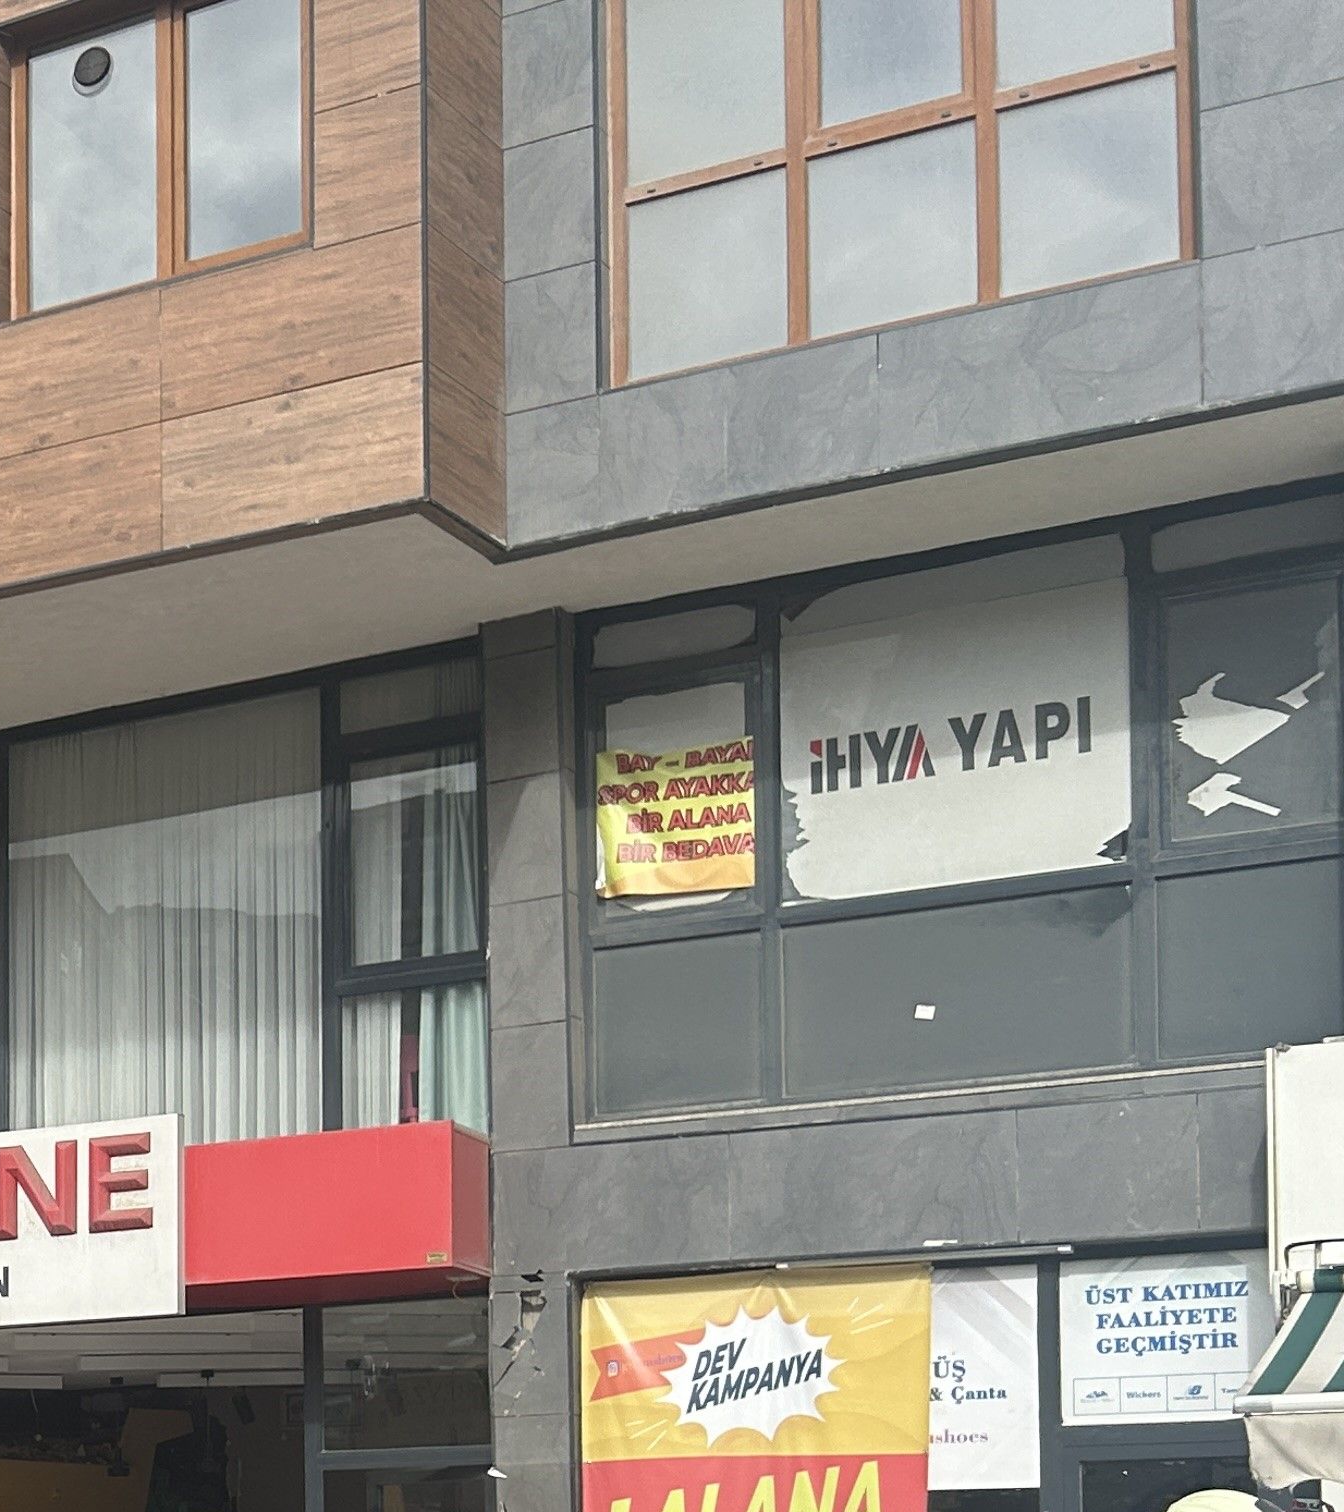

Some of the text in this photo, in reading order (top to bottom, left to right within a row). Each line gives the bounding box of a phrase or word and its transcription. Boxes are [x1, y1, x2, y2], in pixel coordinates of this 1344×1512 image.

[947, 695, 1092, 772] YAPI
[615, 752, 663, 775] BAY
[597, 780, 660, 806] SPOR
[626, 803, 752, 833] BİR ALANA
[616, 832, 755, 864] BİR BEDAVA
[1084, 1280, 1249, 1306] ÜST KATIMIZ
[1095, 1305, 1238, 1330] FAALİYETE
[1096, 1329, 1239, 1357] GEÇMİŞTİR
[691, 1337, 748, 1382] DEV
[685, 1348, 823, 1415] KAMPANYA
[950, 1385, 1008, 1405] Çanta
